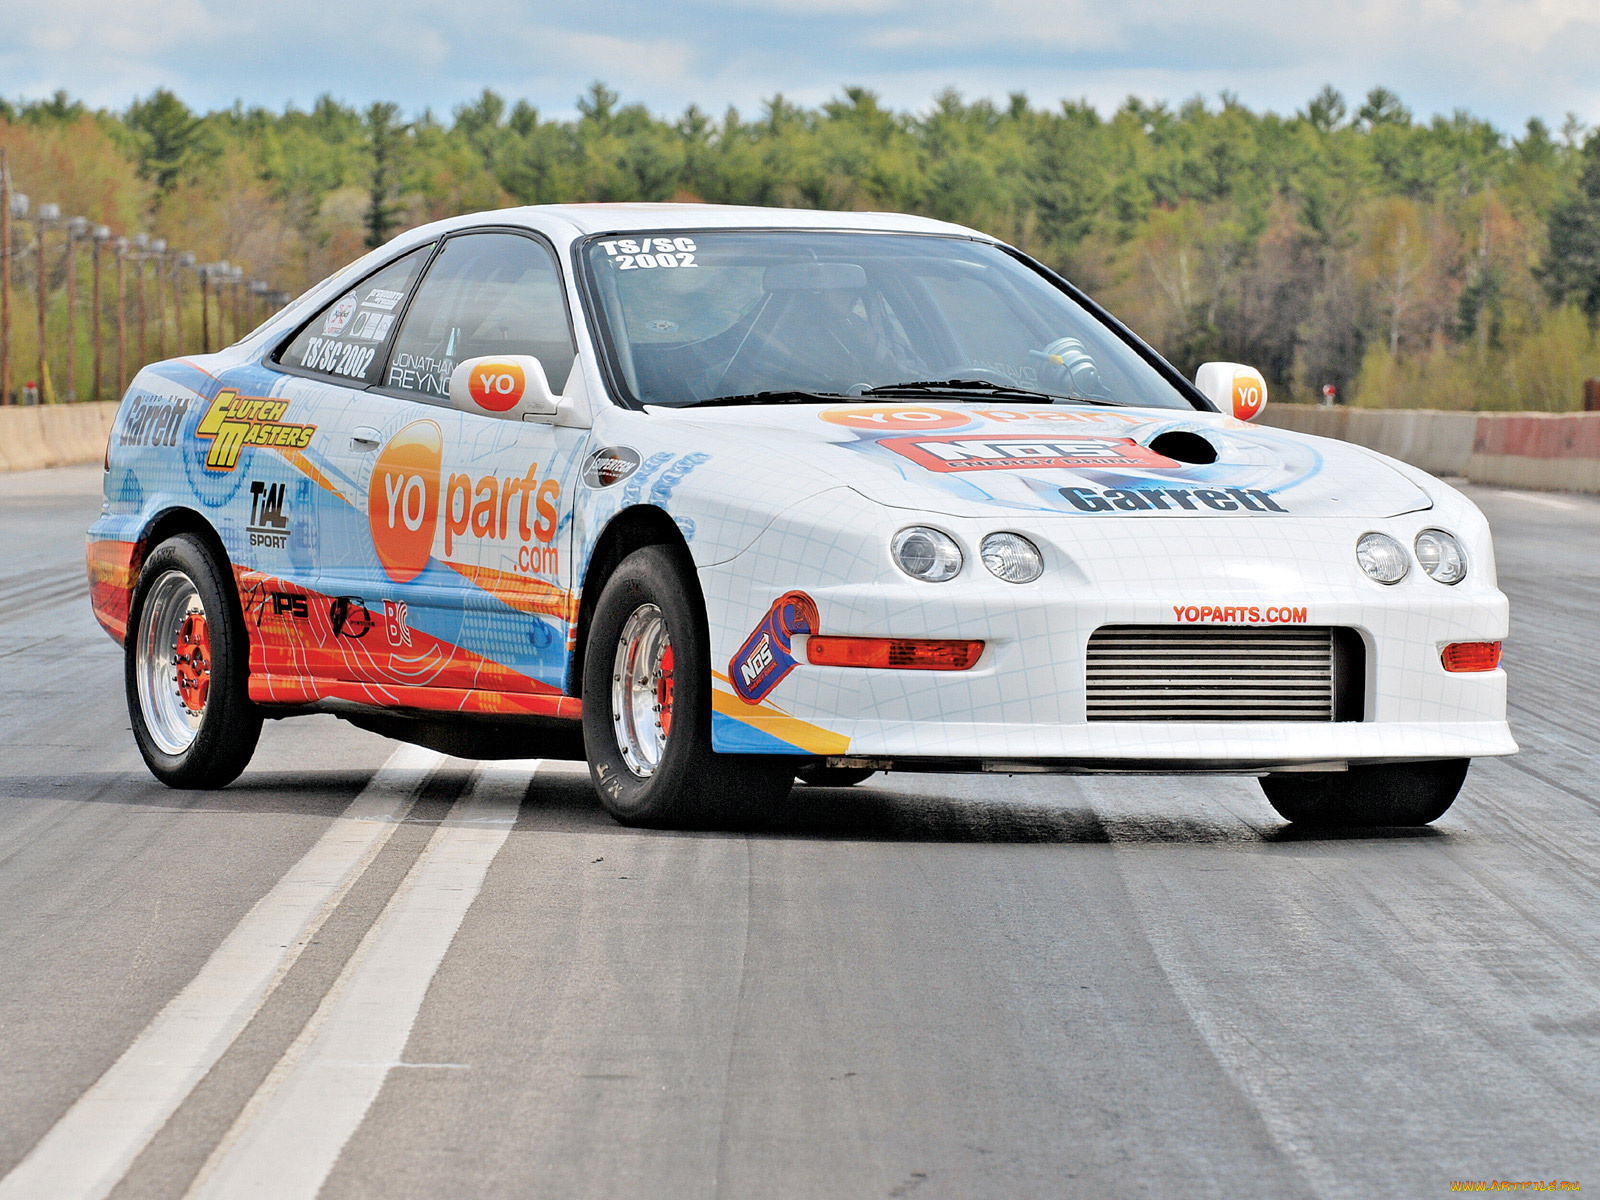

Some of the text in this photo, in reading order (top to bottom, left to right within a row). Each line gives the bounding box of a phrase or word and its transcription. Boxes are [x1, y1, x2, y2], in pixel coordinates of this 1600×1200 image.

[597, 237, 697, 255] TS/SC
[615, 252, 699, 270] 2002
[301, 337, 375, 379] TS/SC 2002
[393, 353, 458, 374] JONATHAN
[480, 374, 515, 394] YO
[1238, 387, 1258, 407] YO
[120, 396, 189, 447] Garrett
[197, 391, 288, 434] CLUTCH
[847, 411, 942, 424] YO
[207, 422, 315, 466] MASTERS
[914, 437, 1124, 461] NOS
[948, 457, 1150, 468] ENERGY DRINK
[385, 462, 560, 557] YO parts
[1058, 487, 1290, 513] Garrett
[250, 534, 287, 549] SPORT
[513, 545, 559, 575] .com
[1173, 605, 1307, 623] YOPARTS.COM
[741, 633, 774, 687] NOS
